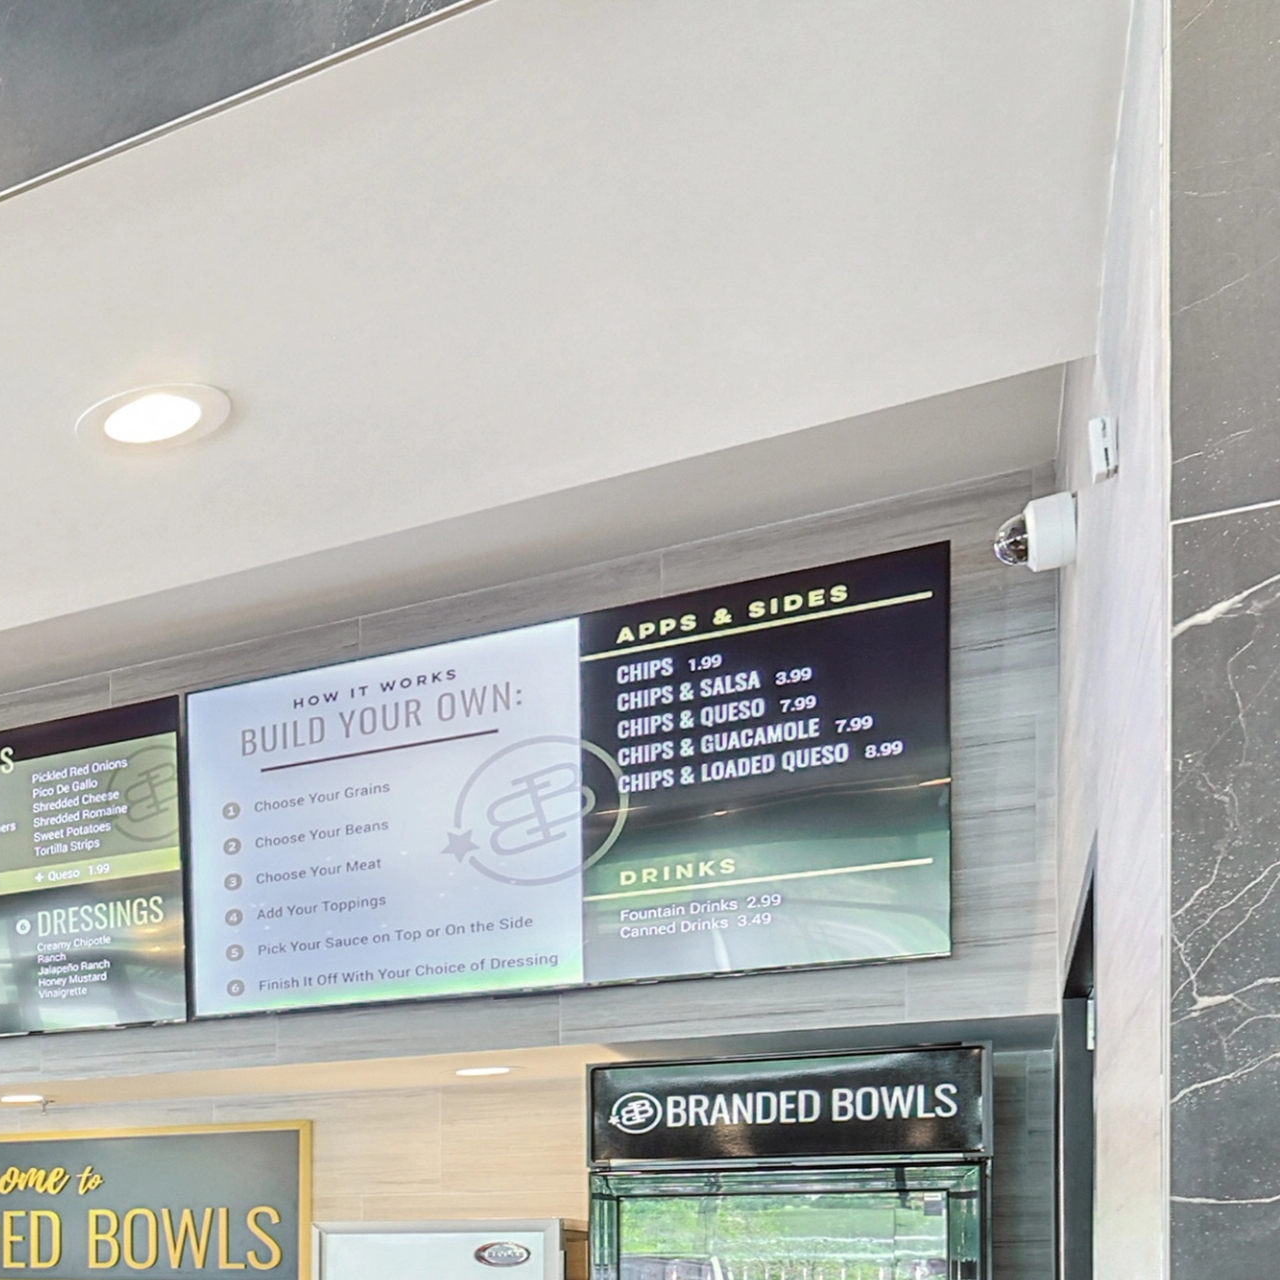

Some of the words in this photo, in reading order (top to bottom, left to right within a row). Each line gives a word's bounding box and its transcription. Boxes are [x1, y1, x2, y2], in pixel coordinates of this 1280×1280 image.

[616, 614, 697, 643] APPS
[713, 607, 732, 625] &
[748, 585, 848, 618] SIDES
[616, 657, 674, 684] CHIPS
[688, 654, 723, 671] 1.99
[293, 691, 339, 709] HOW
[350, 685, 369, 698] IT
[380, 669, 457, 692] WORKS
[617, 685, 674, 711] CHIPS
[680, 682, 694, 701] &
[700, 670, 761, 698] SALSA
[775, 667, 812, 686] 3.99
[242, 716, 325, 757] BUILD
[340, 699, 422, 739] YOUR
[438, 682, 522, 722] OWN:
[617, 713, 674, 739] CHIPS
[680, 710, 694, 729] &
[700, 698, 765, 728] QUESO
[780, 695, 817, 713] 7.99
[618, 741, 674, 767] CHIPS
[680, 738, 694, 757] &
[701, 718, 820, 754] GUACAMOLE
[835, 715, 873, 733] 7.99
[32, 770, 68, 784] Pickled
[69, 764, 90, 777] Red
[91, 759, 128, 773] Onions
[619, 768, 674, 793] CHIPS
[680, 766, 695, 785] &
[701, 754, 775, 782] LOADED
[782, 743, 849, 772] QUESO
[865, 740, 903, 758] 8.99
[32, 786, 54, 799] Pico
[56, 783, 70, 794] De
[72, 778, 98, 792] Gallo
[33, 796, 80, 813] Shredded
[81, 790, 120, 805] Cheese
[254, 795, 305, 813] Choose
[309, 790, 340, 807] Your
[344, 782, 391, 799] Grains
[33, 811, 80, 828] Shredded
[82, 804, 128, 820] Romaine
[33, 828, 65, 842] Sweet
[66, 821, 111, 837] Potatoes
[255, 831, 306, 849] Choose
[309, 827, 341, 843] Your
[345, 819, 390, 836] Beans
[34, 842, 68, 857] Tortilla
[70, 838, 100, 851] Strips
[48, 868, 80, 882] Queso
[88, 863, 110, 875] 1.99
[256, 866, 307, 884] Choose
[310, 863, 341, 878] Your
[346, 858, 382, 873] Meat
[620, 859, 735, 885] DRINKS
[37, 896, 164, 937] DRESSINGS
[256, 907, 283, 920] Add
[286, 903, 318, 918] Your
[322, 895, 387, 915] Toppings
[620, 904, 685, 921] Fountain
[690, 899, 738, 914] Drinks
[747, 894, 781, 909] 2.99
[257, 942, 287, 956] Pick
[290, 938, 321, 952] Your
[325, 933, 368, 949] Sauce
[372, 931, 391, 943] on
[395, 928, 422, 944] Top
[426, 927, 440, 938] or
[445, 923, 465, 936] On
[469, 919, 495, 933] the
[499, 916, 534, 930] Side
[620, 922, 676, 938] Canned
[681, 918, 728, 932] Drinks
[738, 913, 771, 927] 3.49
[37, 940, 72, 952] Creamy
[73, 934, 111, 948] Chipotle
[37, 952, 67, 963] Ranch
[37, 962, 79, 975] Jalapeño
[81, 959, 111, 971] Ranch
[38, 976, 67, 988] Honey
[69, 971, 107, 984] Mustard
[259, 976, 300, 992] Finish
[303, 975, 313, 987] It
[316, 972, 339, 986] Off
[341, 969, 374, 984] With
[377, 966, 411, 980] Your
[415, 961, 466, 977] Choice
[470, 958, 486, 972] of
[490, 953, 559, 971] Dressing
[38, 986, 87, 999] Vinaigrette
[666, 1089, 820, 1129] BRANDED
[831, 1082, 958, 1122] BOWLS
[75, 1165, 104, 1196] to
[88, 1205, 282, 1271] BOWLS
